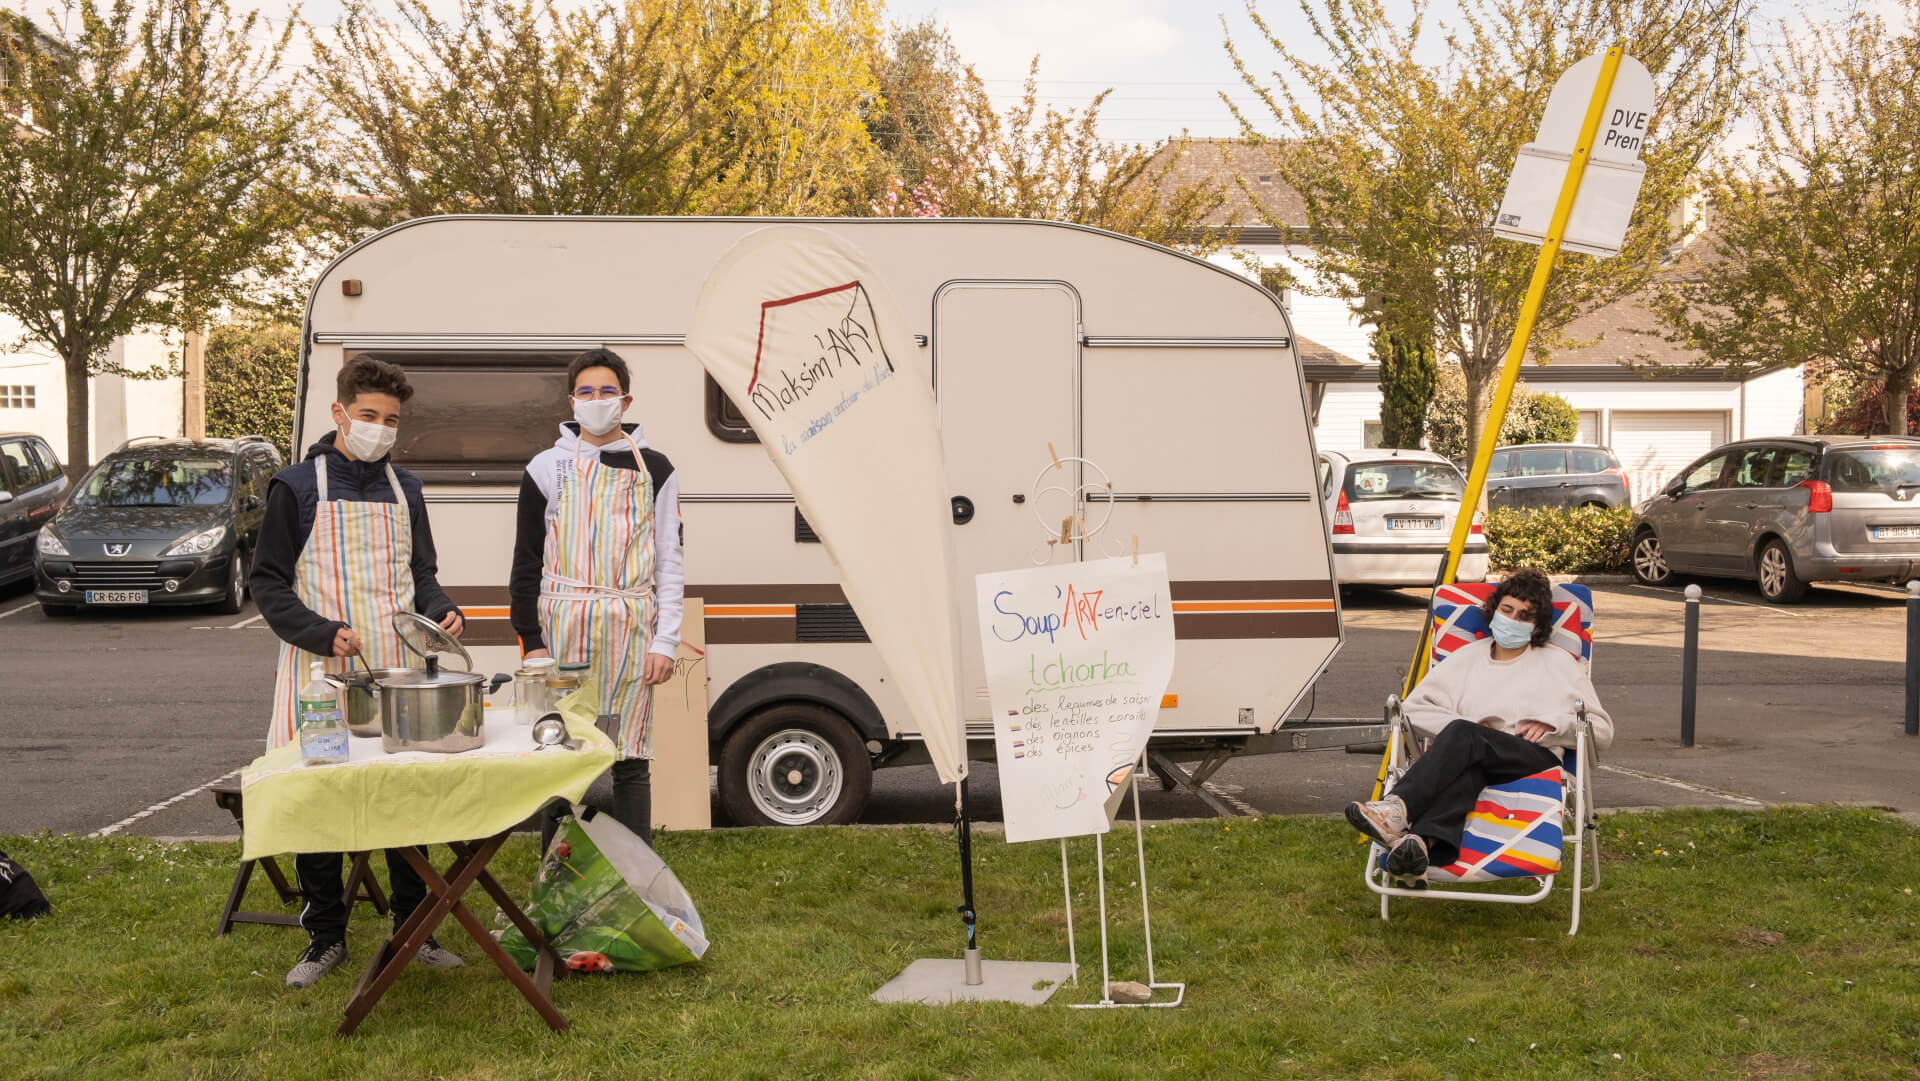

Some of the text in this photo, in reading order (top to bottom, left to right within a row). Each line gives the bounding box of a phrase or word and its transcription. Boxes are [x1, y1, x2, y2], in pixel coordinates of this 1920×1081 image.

[1610, 108, 1648, 130] DVE
[1604, 129, 1640, 151] Pren
[1029, 649, 1136, 687] tchorka
[1022, 697, 1049, 716] des
[1105, 694, 1118, 706] de
[1025, 718, 1042, 730] des
[1050, 712, 1099, 728] lentilles
[1026, 728, 1101, 746] des oignons
[1026, 746, 1043, 758] des
